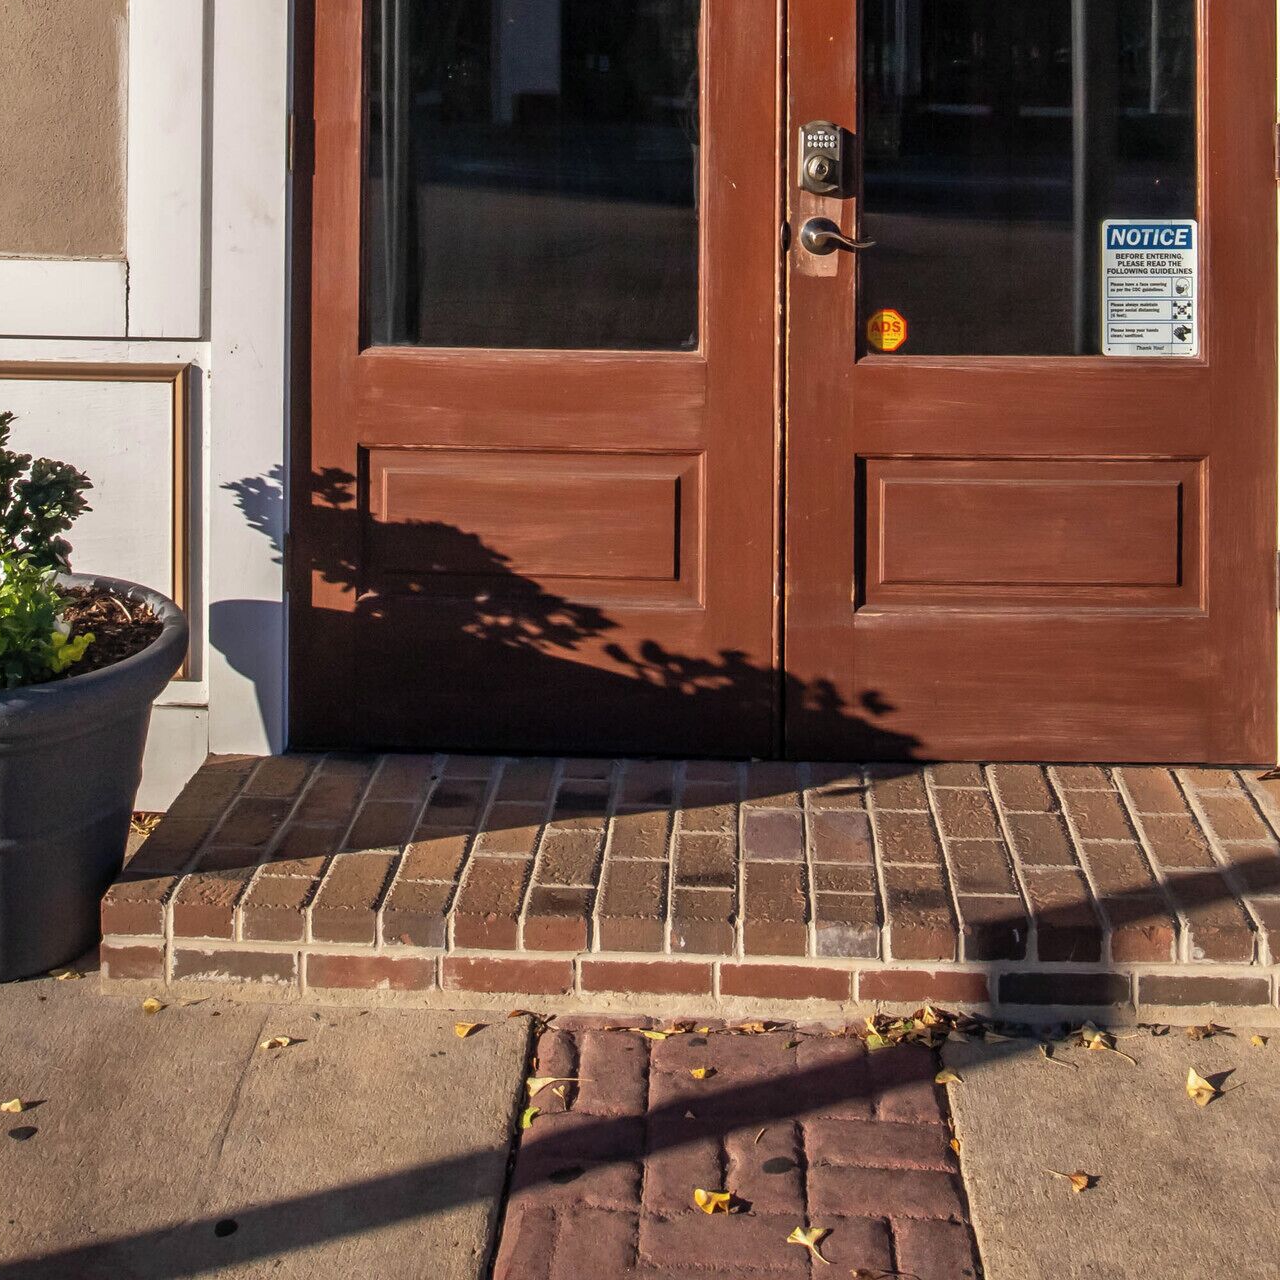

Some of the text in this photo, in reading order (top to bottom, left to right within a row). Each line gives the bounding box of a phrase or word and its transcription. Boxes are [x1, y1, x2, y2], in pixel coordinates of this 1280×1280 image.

[1110, 228, 1189, 246] NOTICE
[1146, 253, 1184, 261] ENTERING,
[871, 321, 901, 333] ADS
